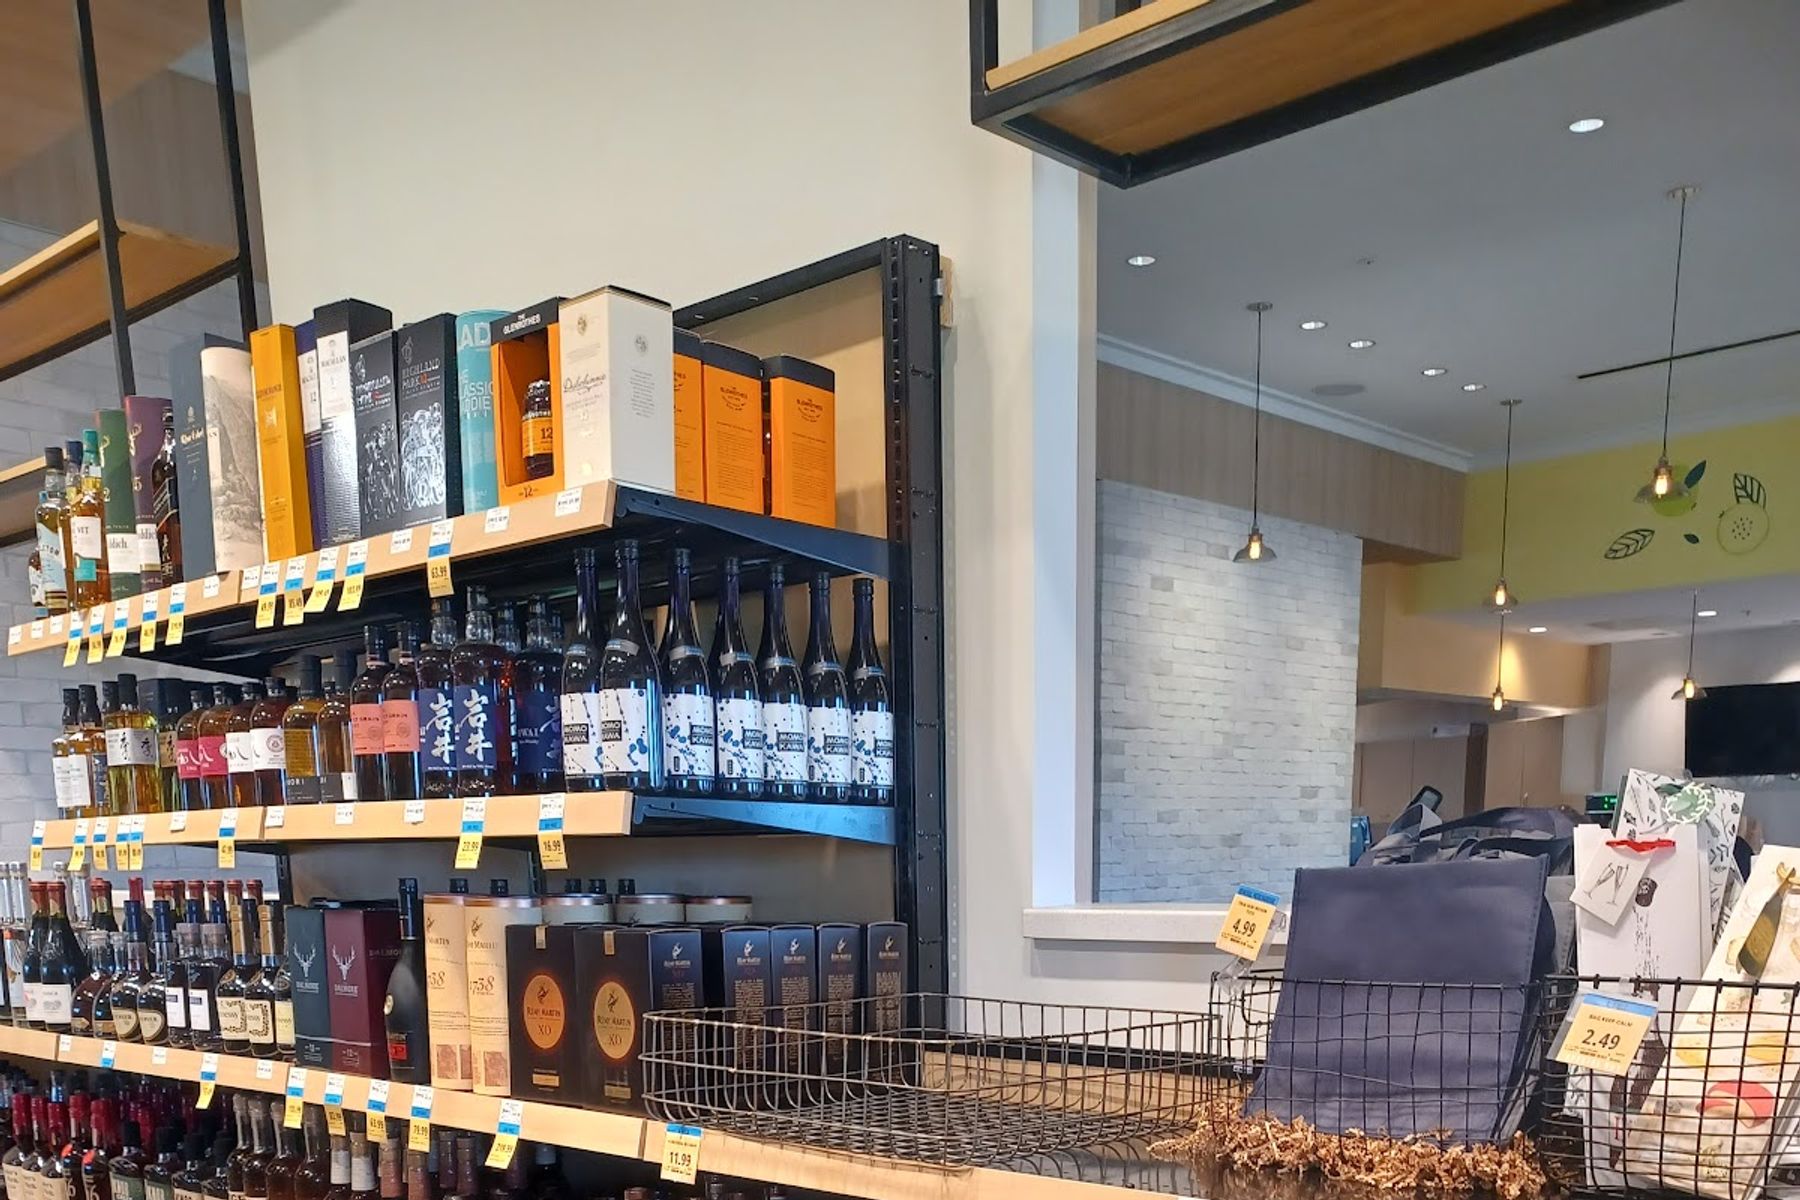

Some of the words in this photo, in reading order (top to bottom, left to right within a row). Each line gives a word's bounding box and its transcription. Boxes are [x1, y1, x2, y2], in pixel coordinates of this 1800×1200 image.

[1232, 918, 1257, 937] 4.99
[369, 948, 400, 957] DALMO
[538, 1024, 552, 1035] XO
[1581, 1029, 1621, 1050] 2.49
[669, 1151, 692, 1166] 11.99
